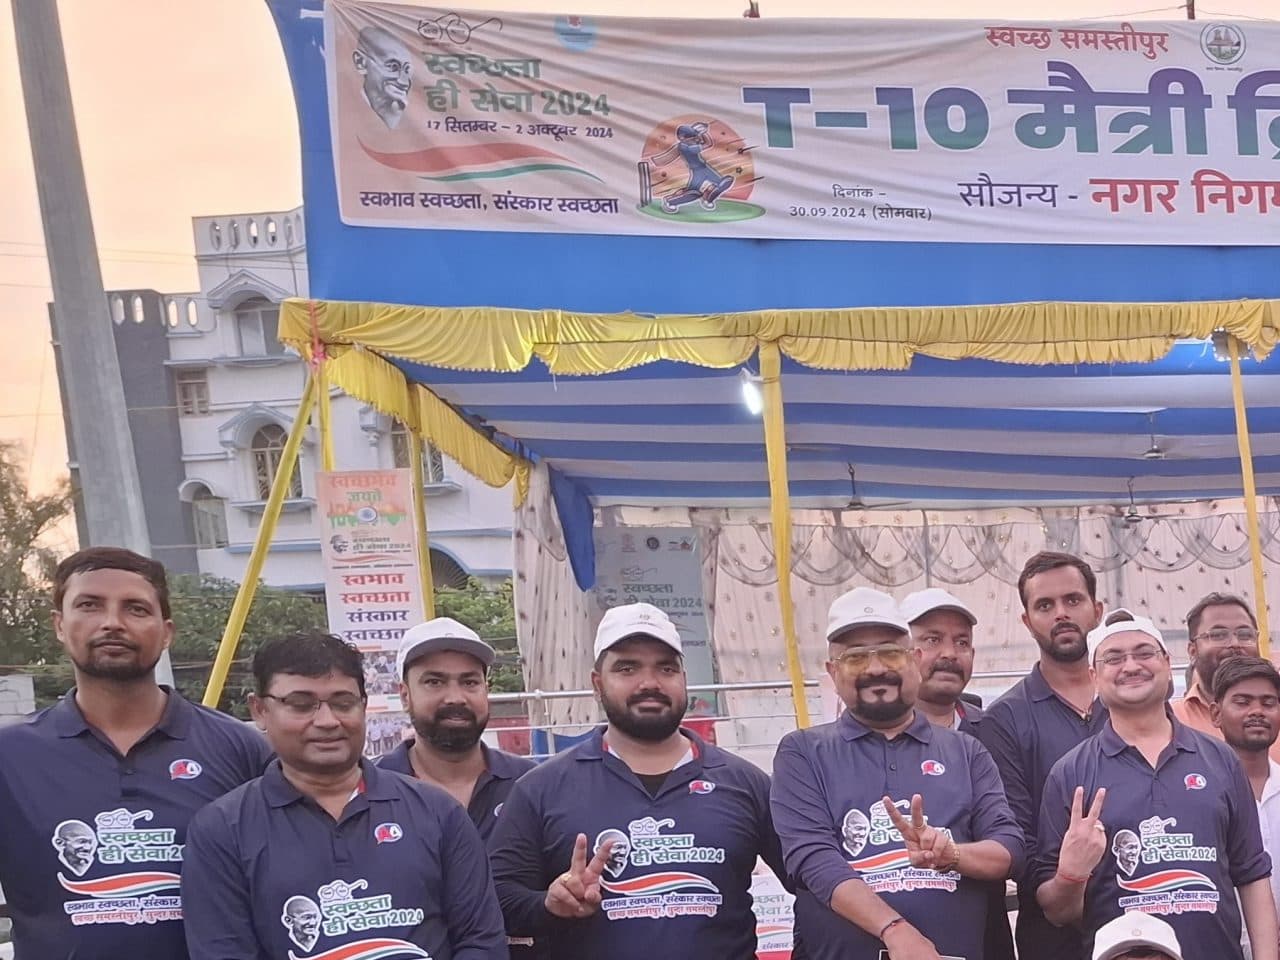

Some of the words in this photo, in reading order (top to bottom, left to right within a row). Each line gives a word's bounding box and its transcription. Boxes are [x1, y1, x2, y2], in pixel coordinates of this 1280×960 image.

[984, 23, 1052, 50] स्वच्छ
[1059, 21, 1170, 60] समस्तीपुर
[424, 79, 461, 113] ही
[470, 82, 534, 113] सेवा
[542, 90, 611, 116] 2024
[741, 84, 990, 153] T-10
[1007, 60, 1212, 158] मैत्री
[586, 126, 613, 138] 2024
[831, 182, 871, 201] दिनांक
[957, 172, 1058, 209] सौजन्य
[1089, 176, 1180, 215] नगर
[360, 191, 415, 209] स्वभाव
[420, 192, 488, 212] स्वच्छता,
[492, 190, 554, 212] संस्कार
[557, 198, 619, 214] स्वच्छता
[788, 204, 867, 219] 30.09.2024
[871, 202, 933, 222] (सोमवार)
[343, 573, 404, 586] स्वभाव
[340, 591, 411, 605] स्वच्छता
[346, 609, 410, 623] संस्कार
[101, 830, 173, 843] स्वच्छता
[633, 836, 692, 848] स्वच्छता
[871, 830, 888, 843] ही
[1143, 835, 1192, 846] स्वच्छता
[101, 846, 122, 861] ही
[130, 848, 168, 860] सेवा
[632, 850, 650, 863] ही
[655, 849, 688, 862] सेवा
[690, 850, 724, 862] 2024
[1143, 849, 1158, 862] ही
[1163, 848, 1189, 860] सेवा
[1192, 850, 1216, 860] 2024
[322, 896, 390, 916] स्वच्छता
[324, 918, 347, 934] ही
[351, 914, 388, 930] सेवा
[390, 909, 423, 925] 2024
